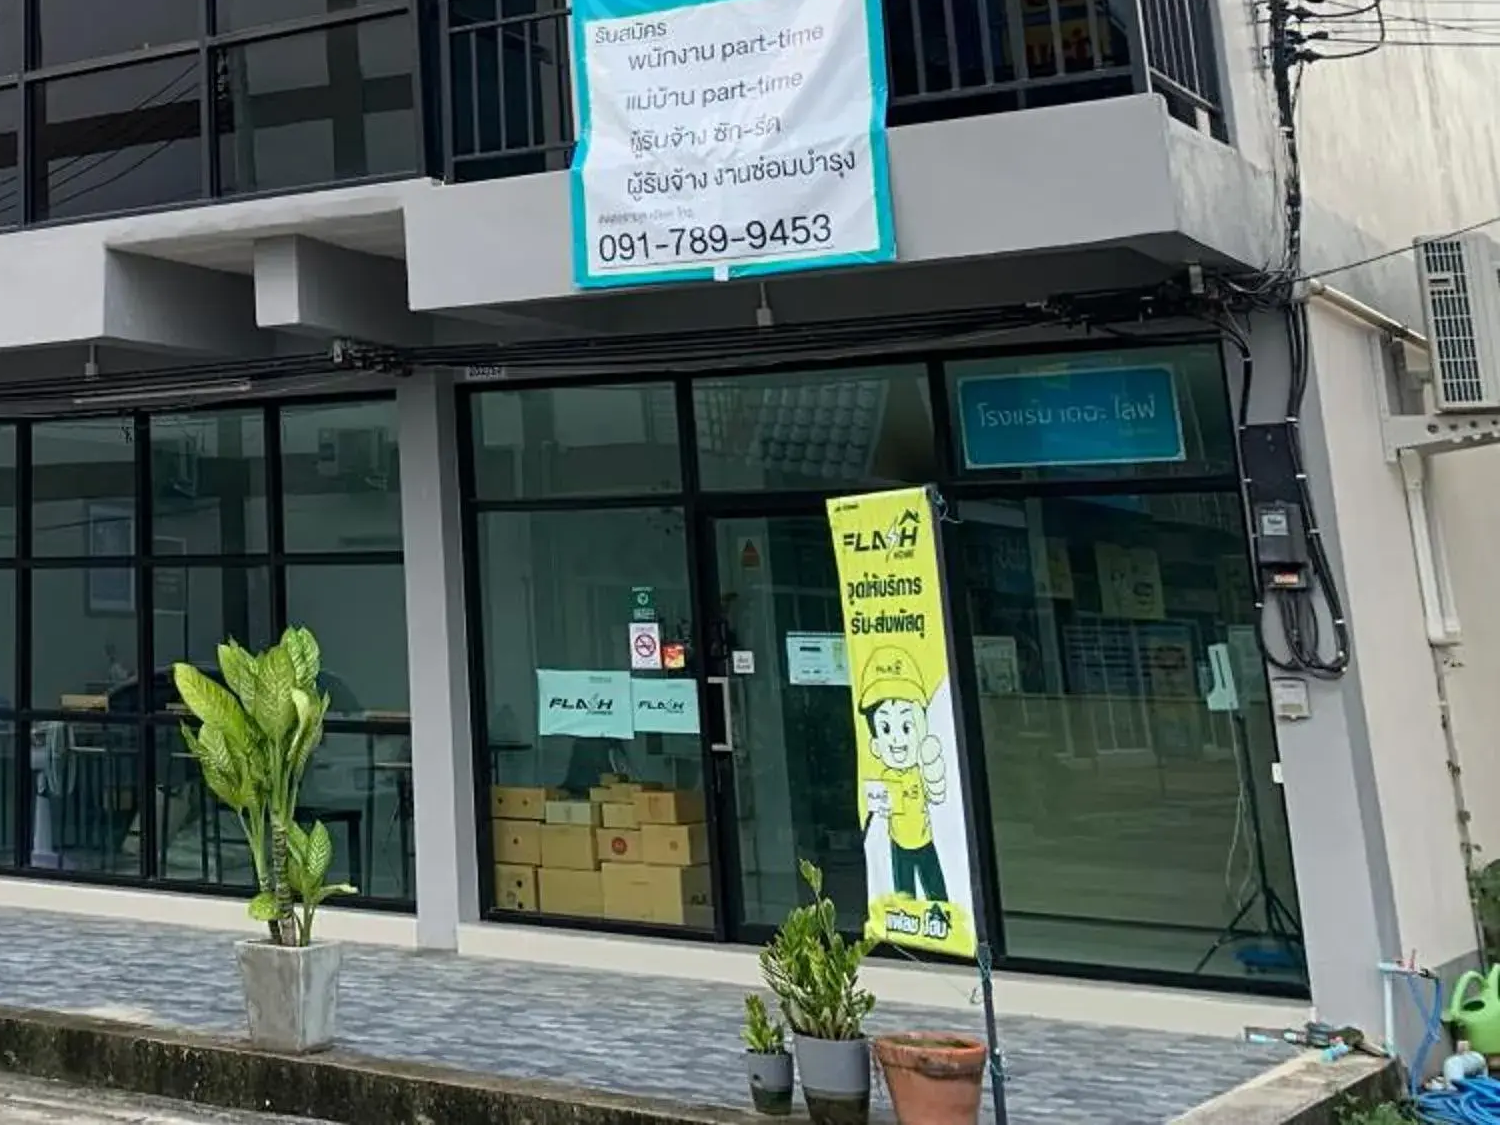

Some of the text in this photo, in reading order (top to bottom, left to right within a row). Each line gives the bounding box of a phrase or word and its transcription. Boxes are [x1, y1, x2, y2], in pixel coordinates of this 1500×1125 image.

[595, 22, 668, 44] รับสมัคร
[627, 25, 824, 71] พนักงาน part-time
[626, 71, 803, 111] แม่บ้าน part-time
[627, 148, 856, 202] ผู้รับจ้าง งานซ่อมบำรุง
[599, 213, 833, 262] 091-789-9453
[847, 571, 922, 606] จุดให้บริการ
[851, 608, 925, 640] รับ-ส่งพัสดุ
